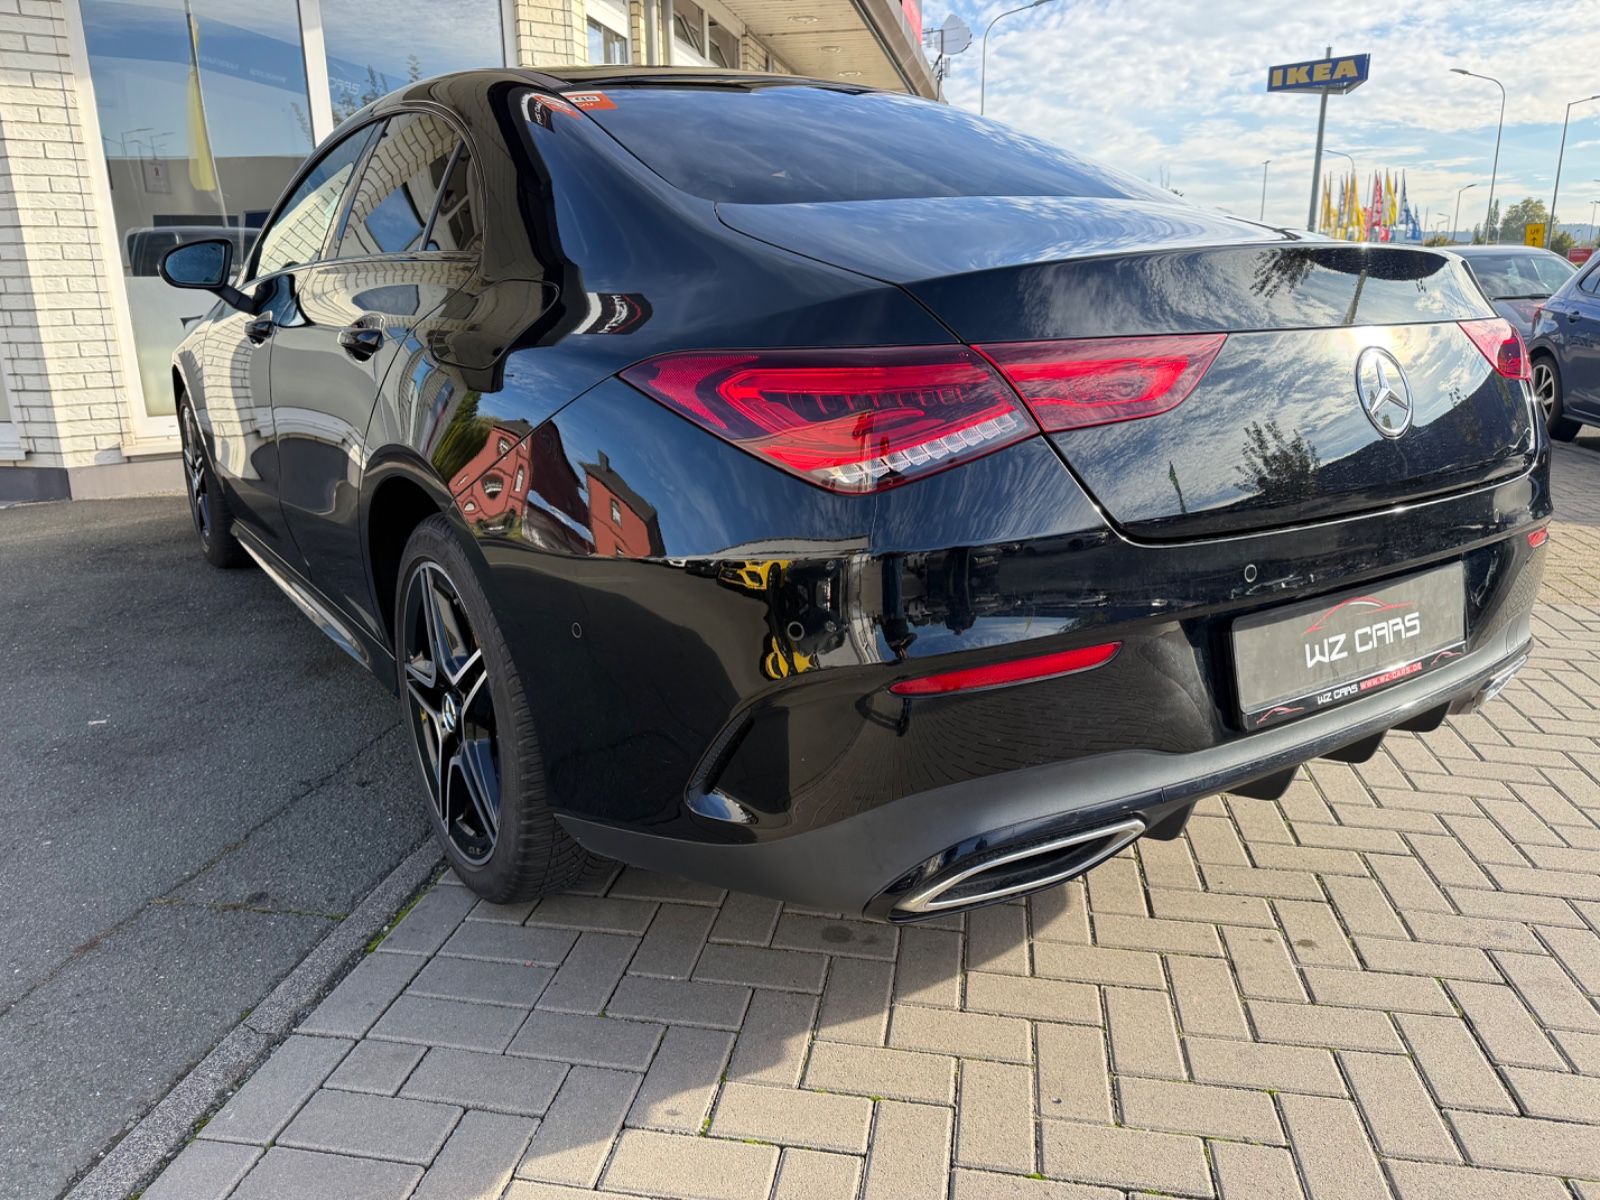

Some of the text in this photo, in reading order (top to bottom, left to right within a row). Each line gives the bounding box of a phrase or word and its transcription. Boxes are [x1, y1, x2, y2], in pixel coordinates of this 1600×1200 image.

[1271, 60, 1358, 87] IKEA
[1305, 612, 1420, 668] WZ CARS
[1317, 694, 1332, 705] WZ
[1333, 684, 1358, 700] CARS
